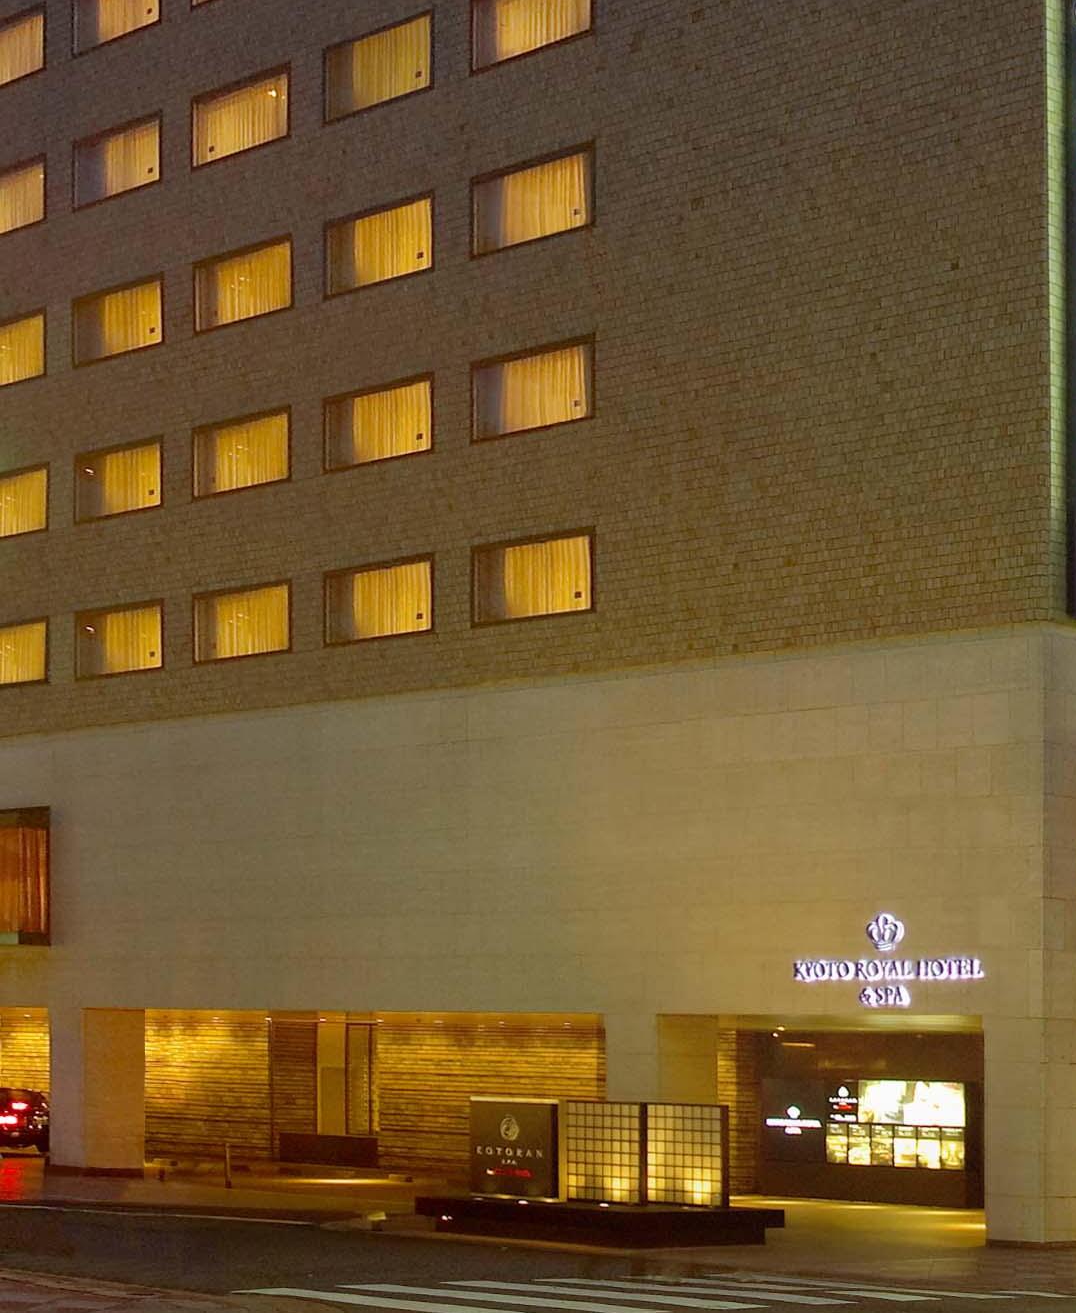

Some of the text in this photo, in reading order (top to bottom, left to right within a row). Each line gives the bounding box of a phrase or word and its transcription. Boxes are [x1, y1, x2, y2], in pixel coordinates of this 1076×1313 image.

[793, 956, 985, 982] KYOTO ROYAL HOTEL
[859, 985, 911, 1007] & SPA
